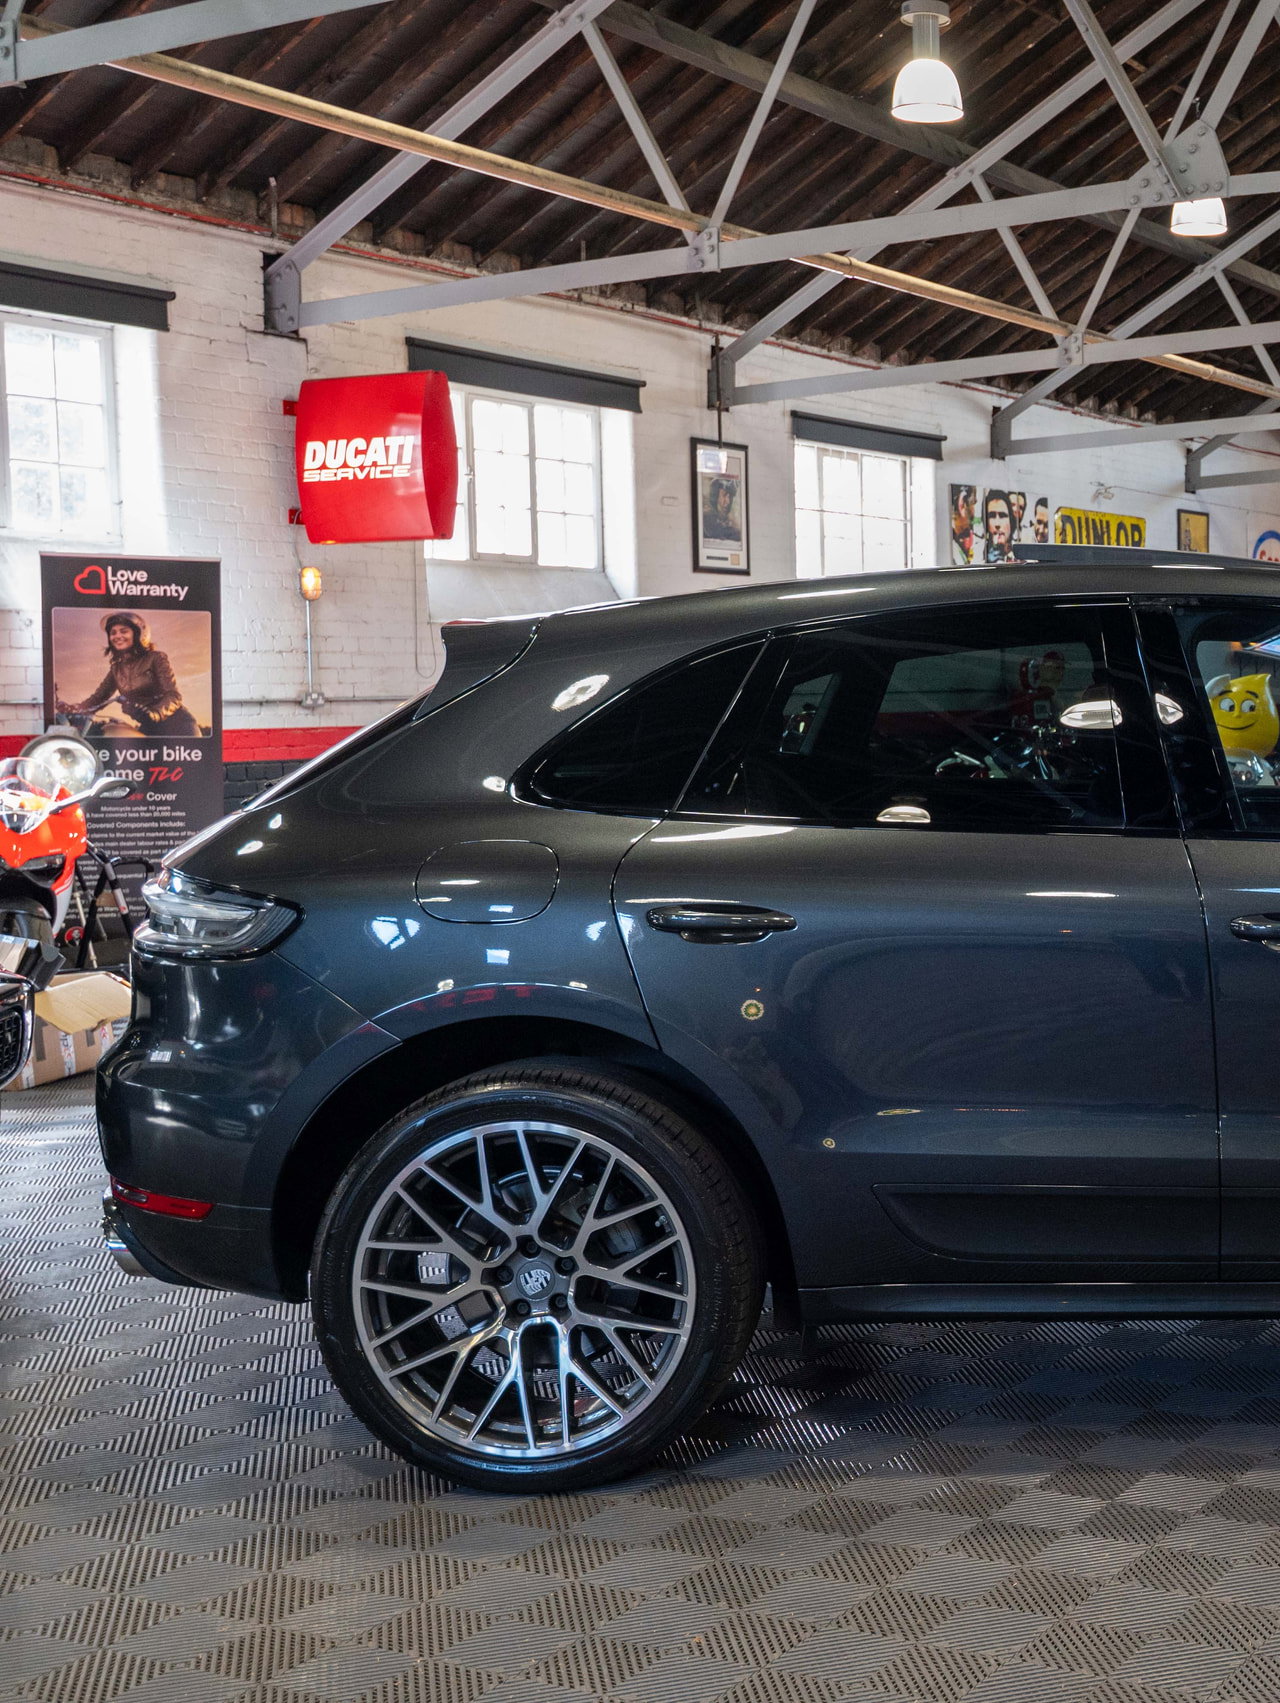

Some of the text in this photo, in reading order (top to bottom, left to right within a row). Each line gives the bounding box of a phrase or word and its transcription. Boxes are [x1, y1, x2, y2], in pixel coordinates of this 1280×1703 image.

[303, 435, 415, 470] DUCATI
[302, 465, 411, 483] SERVICE
[107, 565, 148, 582] Love
[108, 580, 189, 601] Warranty
[115, 749, 159, 765] your
[162, 745, 203, 762] bike
[103, 768, 145, 782] ome
[146, 791, 178, 801] Cover
